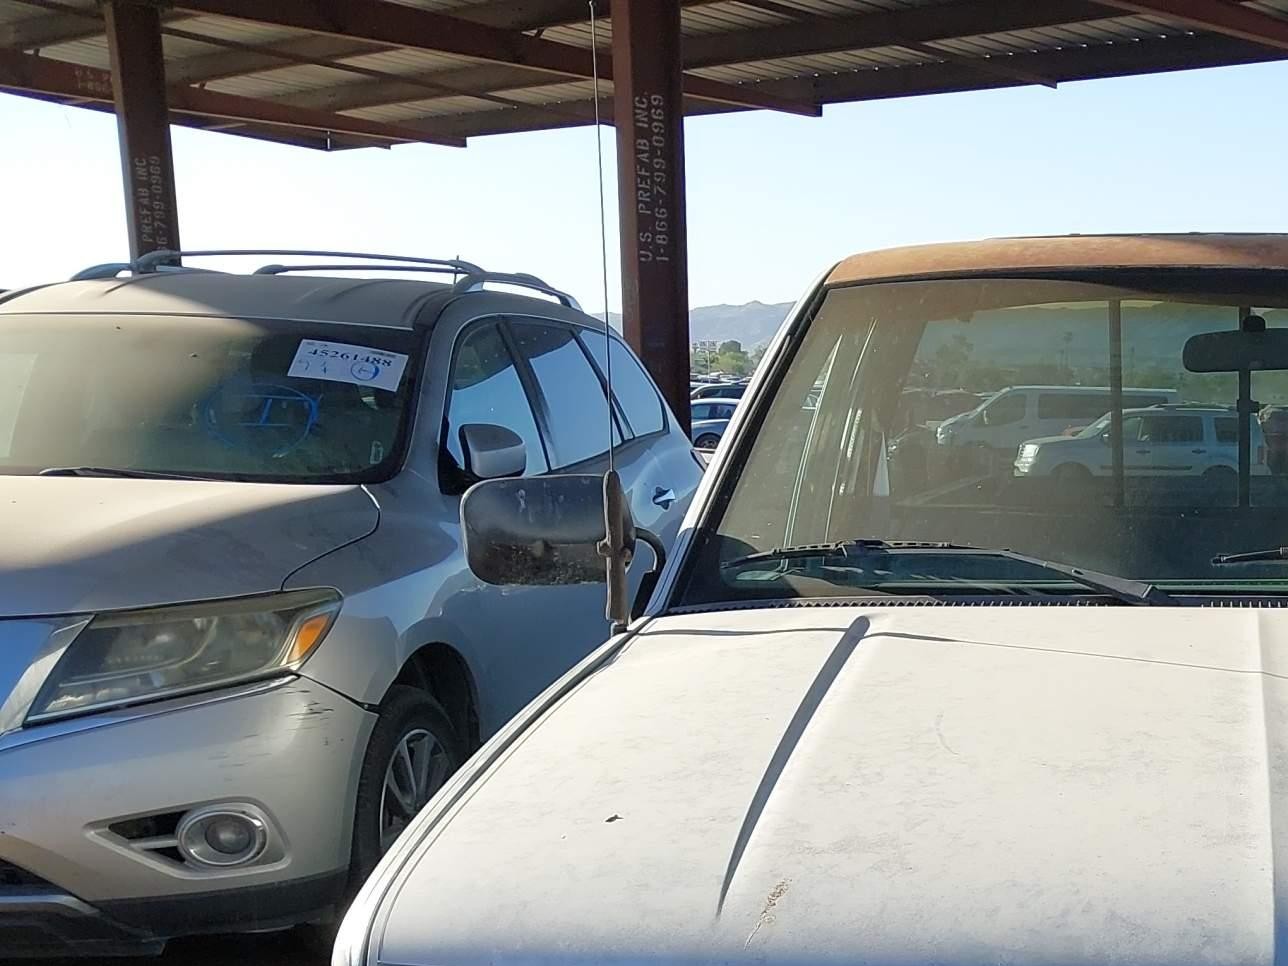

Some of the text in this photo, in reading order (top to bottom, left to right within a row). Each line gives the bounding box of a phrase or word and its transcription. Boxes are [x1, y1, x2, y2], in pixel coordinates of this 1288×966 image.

[634, 91, 653, 262] U.S. PREFAB INC.
[650, 95, 670, 262] 1-866-799-0969
[308, 348, 393, 368] 45261488
